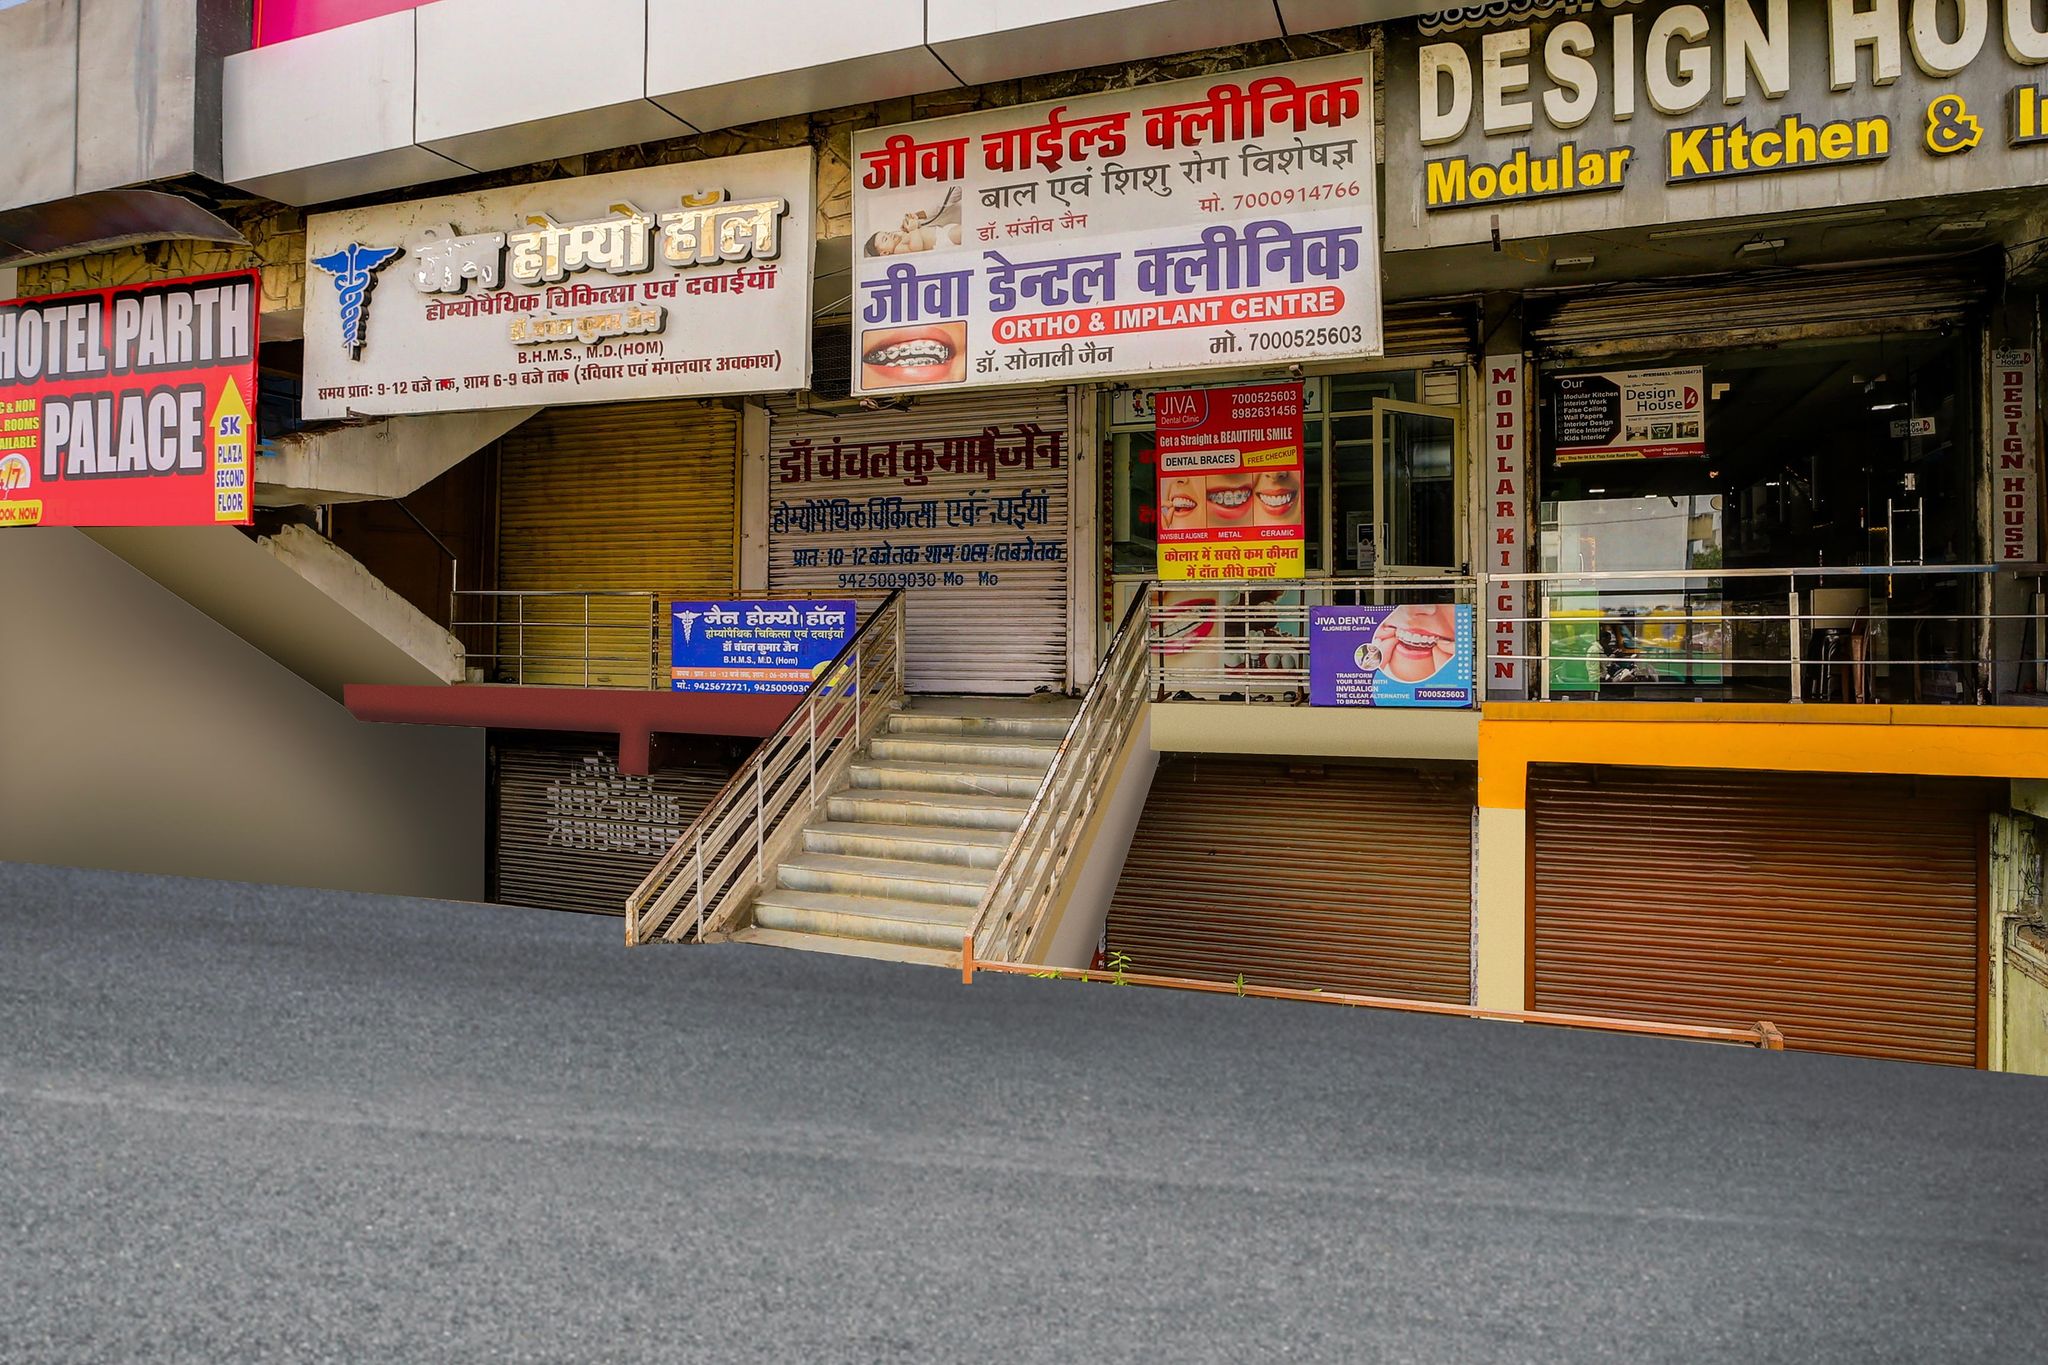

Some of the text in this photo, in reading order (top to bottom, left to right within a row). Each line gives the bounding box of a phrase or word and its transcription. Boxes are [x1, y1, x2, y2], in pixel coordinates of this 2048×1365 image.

[1418, 0, 1791, 147] DESIGN
[860, 74, 1364, 190] जीवा चाईल्ड क्लीनिक
[1426, 93, 1985, 206] Modular Kitchen &
[978, 136, 1358, 210] बाल एवं शिशु रोग विशेषज्ञ
[1198, 180, 1361, 212] मो. 7000914766
[976, 211, 1088, 241] डॉ. संजीव जैन
[511, 190, 781, 282] होम्यो हॉल
[860, 217, 1364, 325] जीवा डेन्टल क्लीनिक
[426, 295, 539, 321] होम्योपैथिक
[546, 284, 636, 310] चिकित्सा
[643, 274, 679, 298] एवं
[999, 290, 1336, 341] ORTHO & IMPLANT CENTRE
[0, 284, 250, 379] HOTEL PARTH
[1209, 325, 1363, 355] मो. 7000525603
[518, 340, 664, 364] B.H.M.S., M.D.(HOM)
[975, 344, 1114, 373] डॉ. सोनाली जैन
[318, 387, 345, 400] समय
[378, 382, 408, 395] 9-12
[463, 374, 489, 388] शाम
[494, 372, 517, 387] 6-9
[521, 368, 544, 384] बजे
[547, 368, 569, 383] तक
[573, 363, 625, 384] (रविवार
[628, 358, 648, 378] एवं
[651, 356, 713, 376] मंगलवार
[716, 350, 783, 373] अवकाश)
[1561, 379, 1584, 390] Our
[1161, 390, 1297, 416] JIVA 7000525603
[1563, 391, 1619, 400] Modular Kitchen
[1586, 398, 1607, 406] Work
[1626, 388, 1676, 402] Design
[15, 399, 36, 412] NON
[1231, 405, 1297, 420] 8982631456
[1636, 399, 1683, 412] House
[4, 417, 40, 431] ROOMS
[220, 415, 241, 435] SK
[1161, 415, 1200, 425] Dental Clinic
[1589, 419, 1614, 428] Design
[2000, 371, 2025, 470] DESIGN
[43, 391, 202, 476] PALACE
[1160, 426, 1293, 447] Get a Straight & BEAUTIFUL SMILE
[1580, 433, 1606, 441] Interior
[1585, 426, 1610, 434] Interior
[1492, 367, 1516, 518] MODULAR
[217, 445, 243, 463] PLAZA
[1166, 455, 1199, 467] DENTAL
[1200, 454, 1236, 465] BRACES
[1247, 455, 1265, 465] FREE
[1265, 449, 1296, 461] CHECKUP
[216, 469, 245, 487] SECOND
[217, 494, 243, 511] FLOOR
[18, 507, 39, 519] NOW
[2003, 477, 2024, 559] HOUSE
[1160, 529, 1295, 541] INVISIBLE ALIGNER METAL CERAMIC
[1164, 545, 1299, 562] कोलार में सबसे कम कीमत
[1186, 564, 1197, 578] में
[703, 604, 846, 625] जैन होम्यो हॉल
[1315, 615, 1378, 626] JIVA DENTAL
[755, 628, 791, 639] चिकित्सा
[794, 628, 809, 640] एवं
[734, 641, 756, 652] चंचल
[757, 642, 781, 654] कुमार
[782, 640, 799, 652] जैन
[723, 655, 756, 665] B.H.M.S.,
[775, 656, 799, 666] (Hom)
[693, 681, 750, 694] 9425672721,
[1417, 690, 1465, 699] 7000525603
